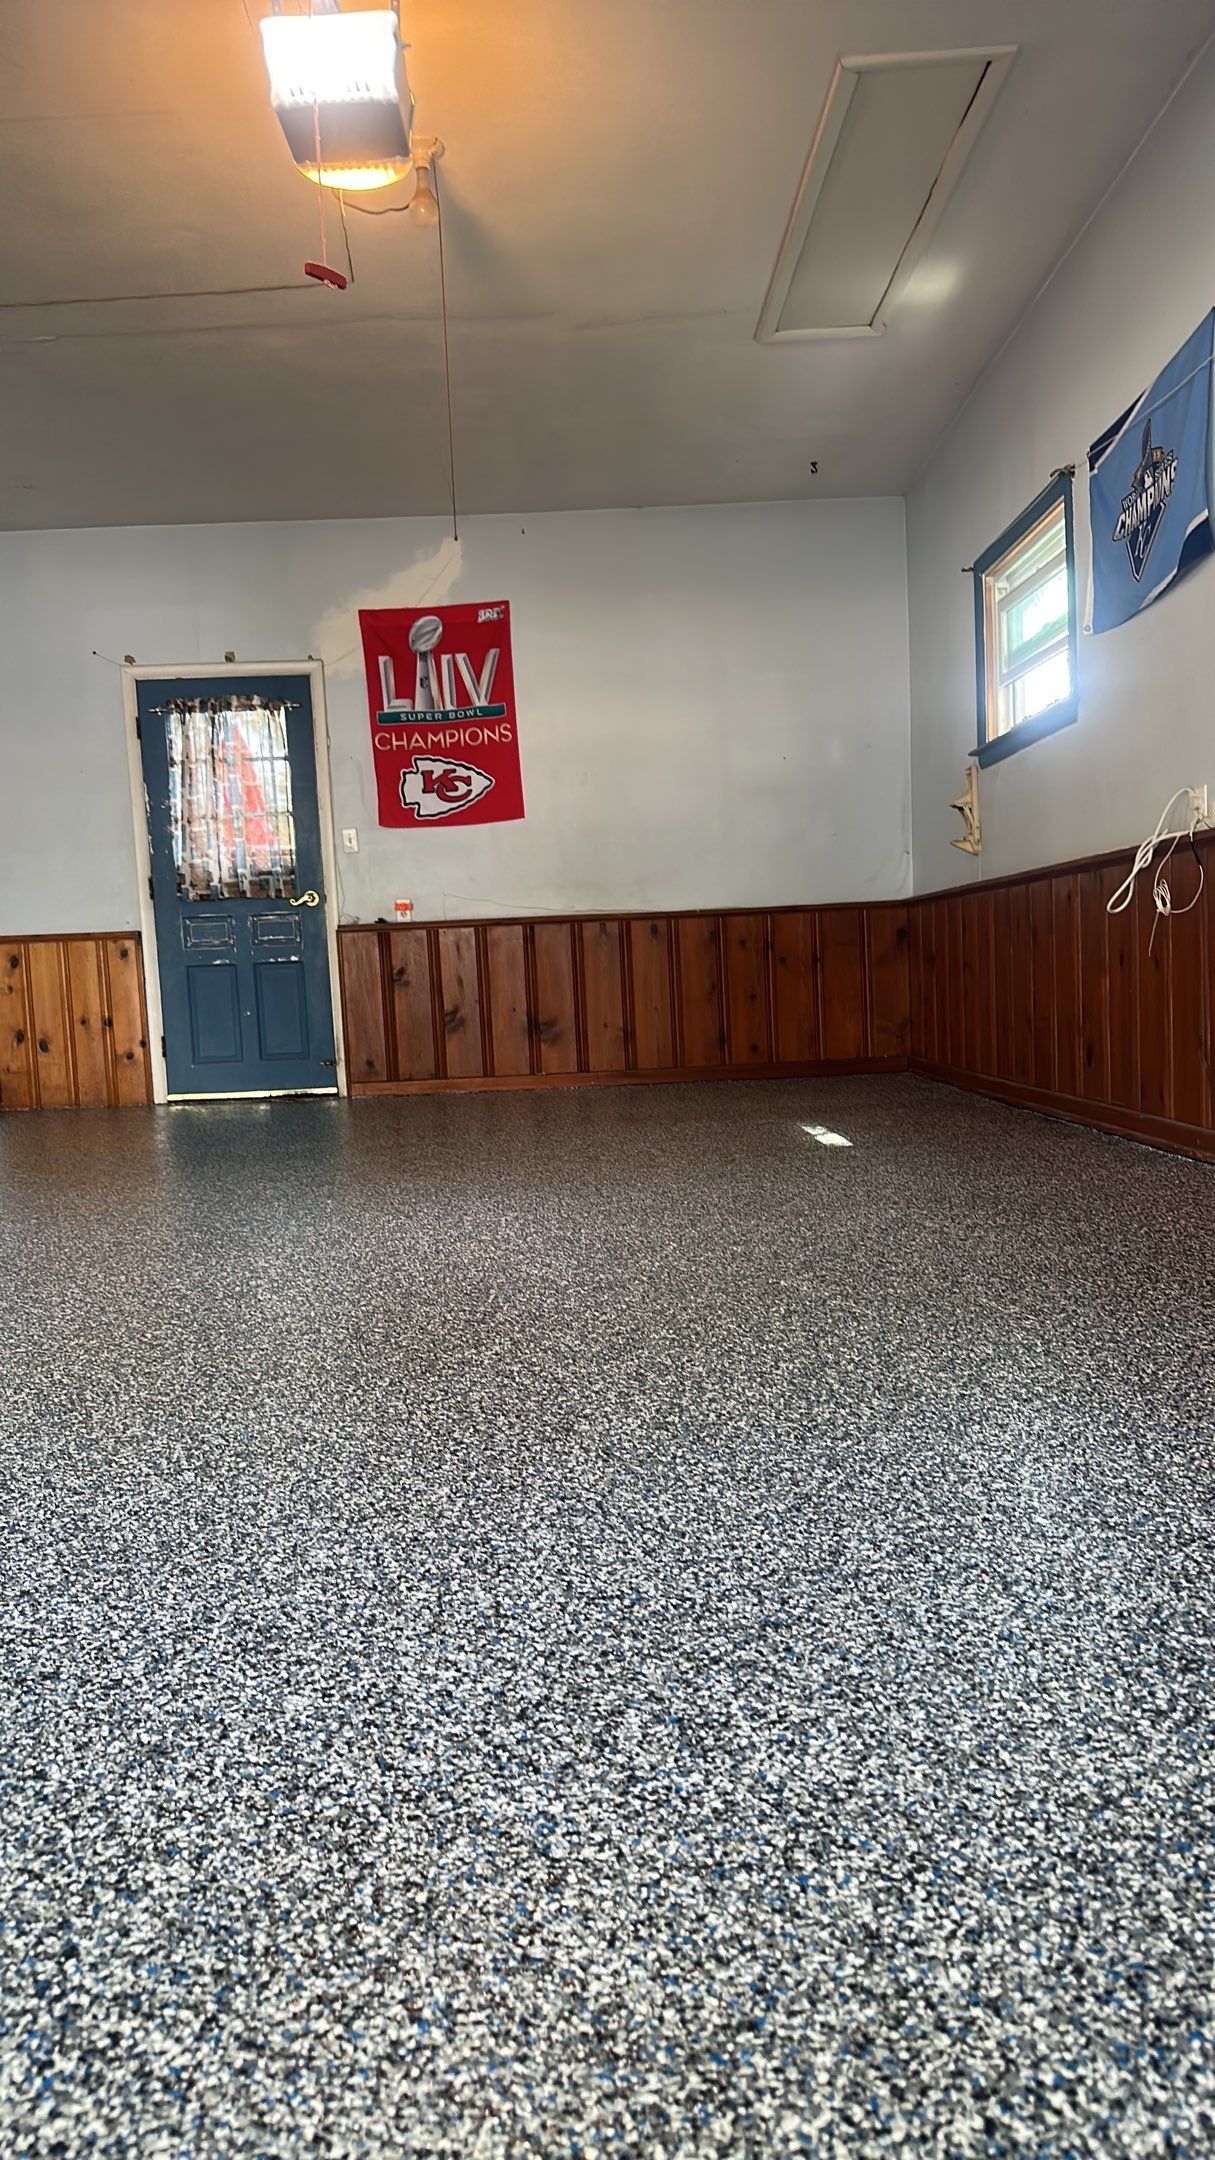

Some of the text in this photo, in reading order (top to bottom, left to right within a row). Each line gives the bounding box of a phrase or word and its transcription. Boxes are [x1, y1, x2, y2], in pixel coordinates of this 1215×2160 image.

[400, 708, 483, 722] SUPER BOWL
[374, 723, 513, 751] CHAMPIONS
[421, 768, 473, 803] KC
